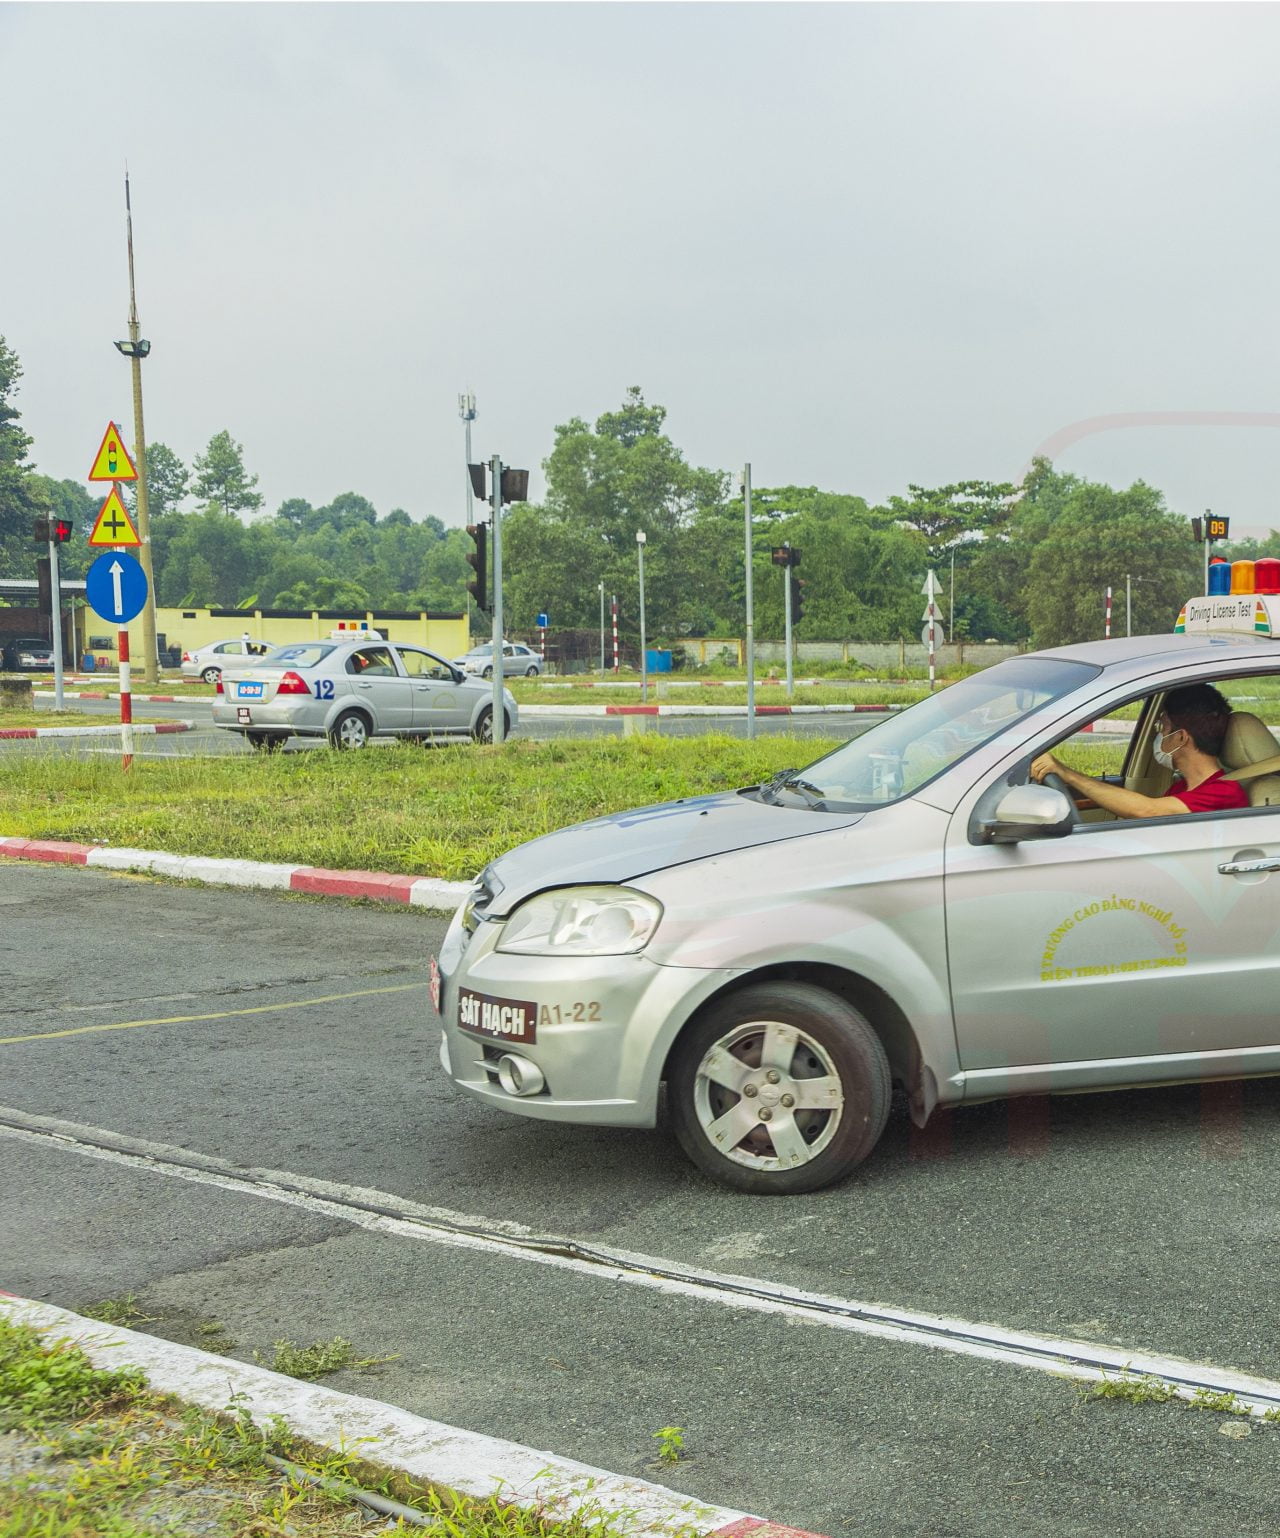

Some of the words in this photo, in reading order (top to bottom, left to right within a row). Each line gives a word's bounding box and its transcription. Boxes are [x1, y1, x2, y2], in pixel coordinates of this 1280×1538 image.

[1211, 520, 1225, 535] 09
[1190, 605, 1211, 622] Driving
[1213, 601, 1236, 619] License
[1238, 601, 1251, 618] Test
[314, 679, 335, 700] 12
[1074, 902, 1101, 922] CAO
[461, 994, 481, 1027] SÁT
[481, 1001, 525, 1036] HẠCH
[539, 1001, 602, 1026] A1-22
